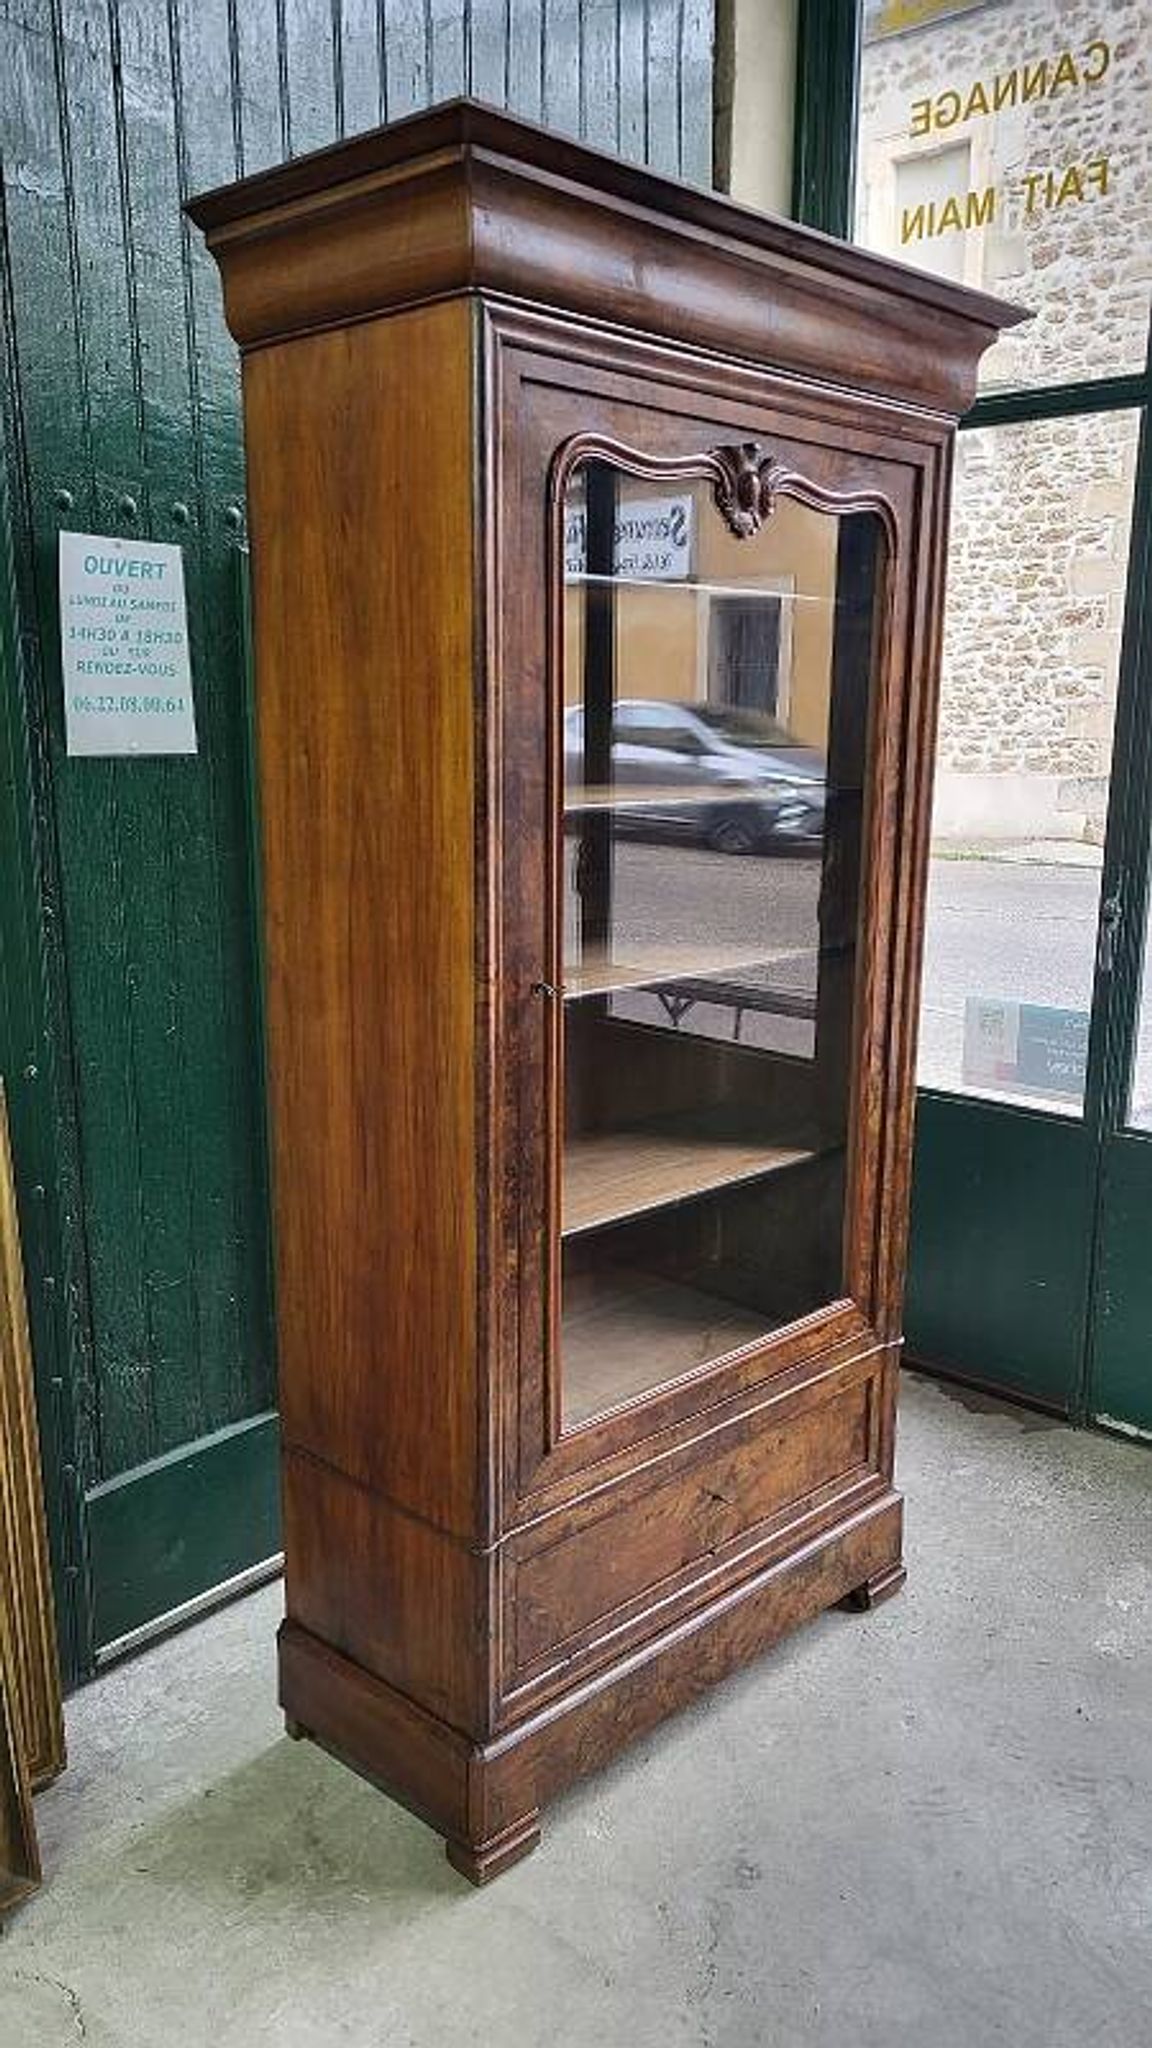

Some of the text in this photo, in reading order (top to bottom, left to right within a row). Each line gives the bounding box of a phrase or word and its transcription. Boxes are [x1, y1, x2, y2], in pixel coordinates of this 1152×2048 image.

[84, 555, 167, 579] OUVERT
[69, 626, 116, 642] 14H30
[138, 629, 183, 644] 18H30
[76, 660, 176, 677] RENDEZ-VOUS
